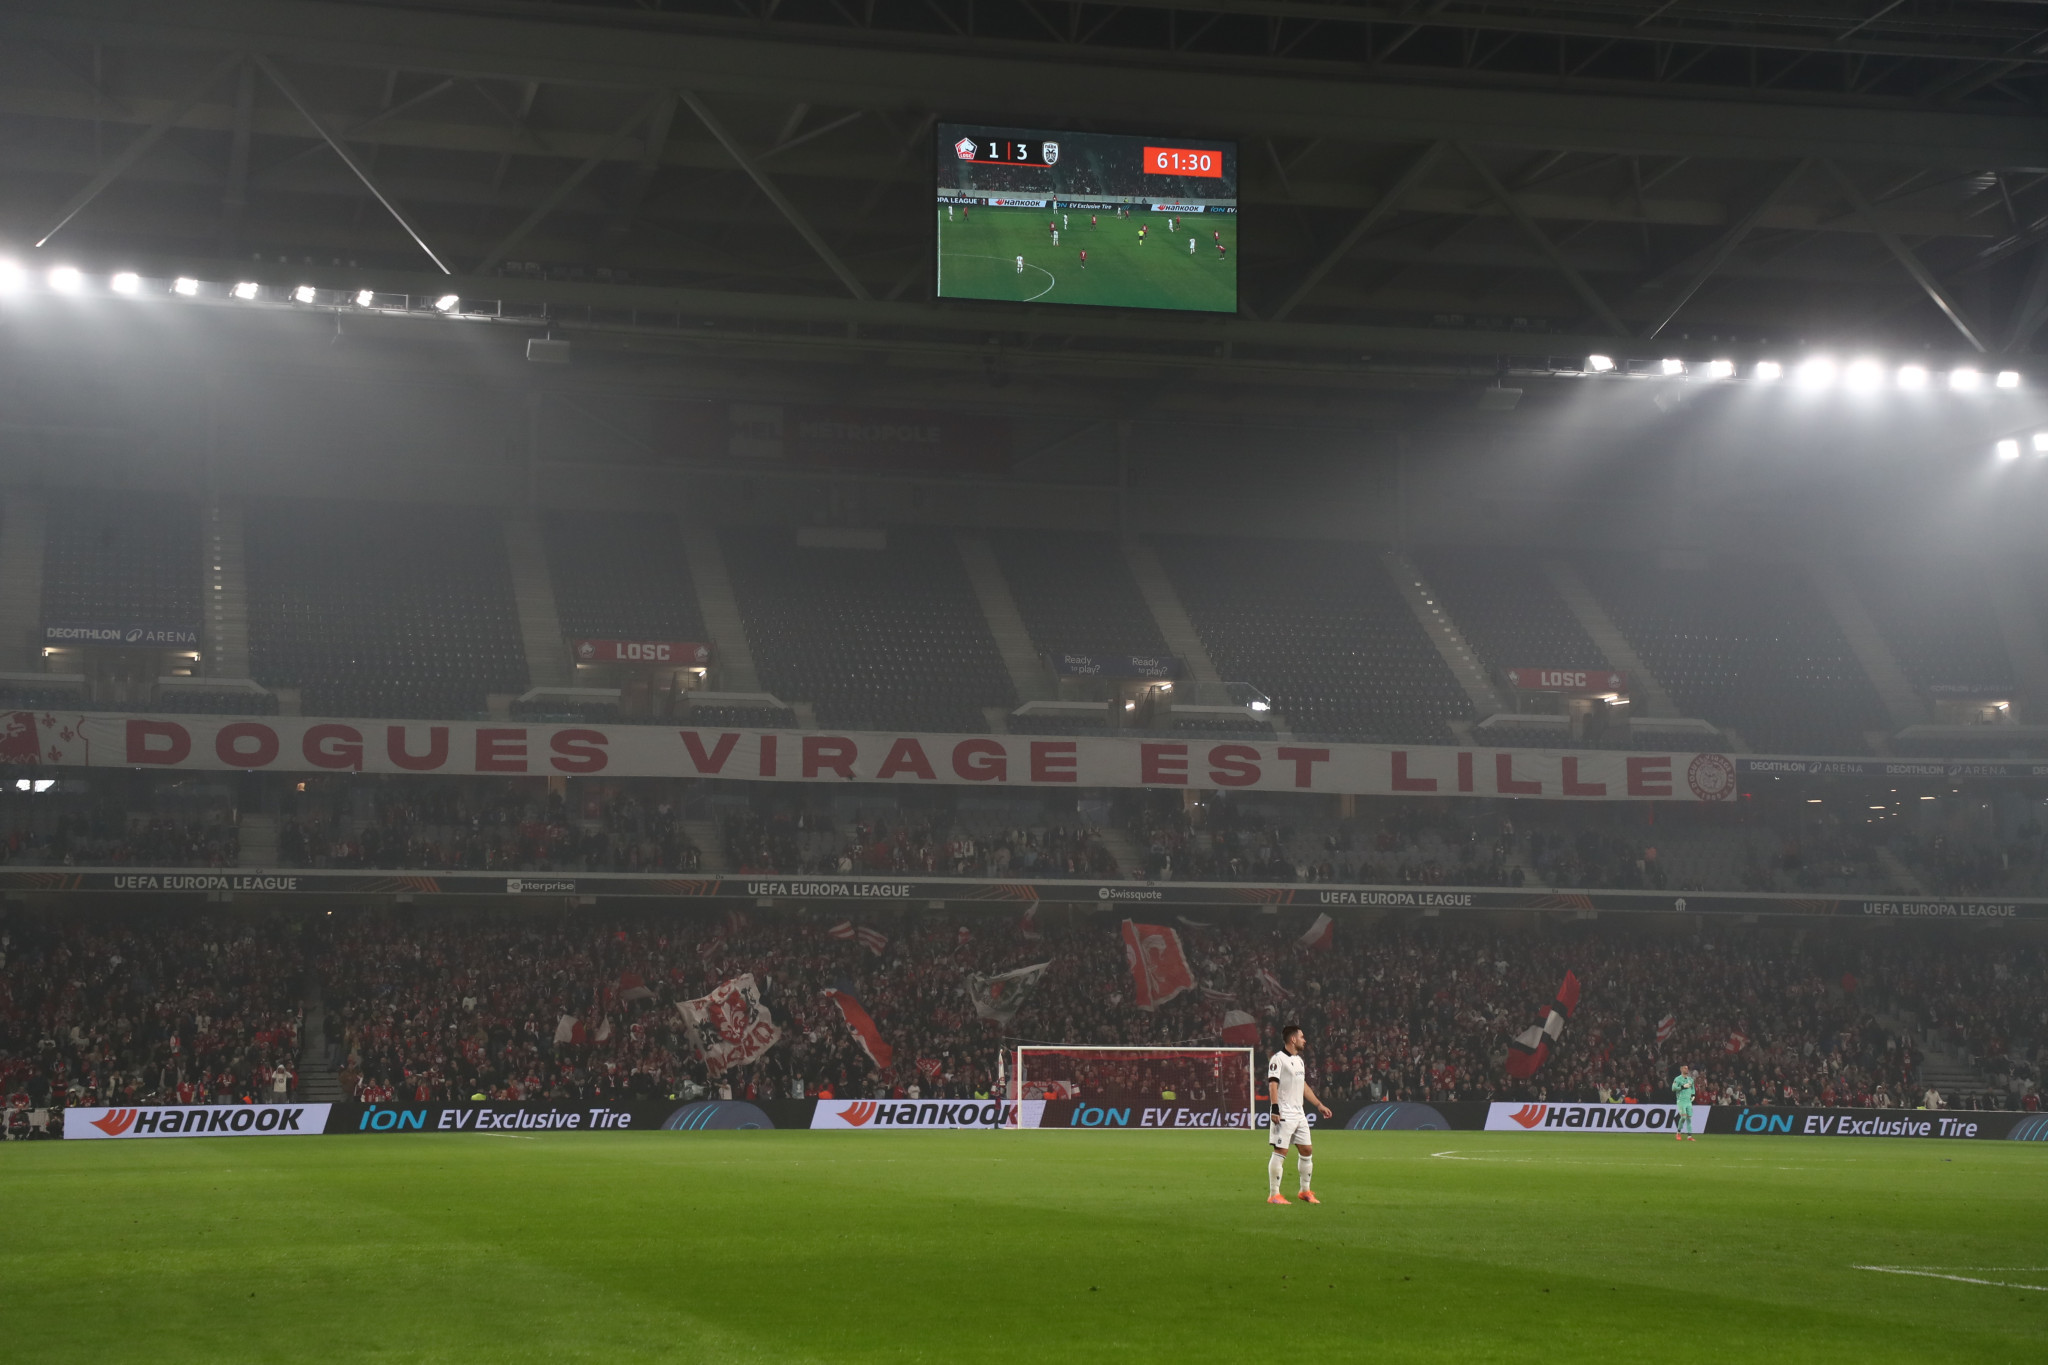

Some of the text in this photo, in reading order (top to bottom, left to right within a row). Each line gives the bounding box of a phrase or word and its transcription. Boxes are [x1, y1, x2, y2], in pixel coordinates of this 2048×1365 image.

[989, 142, 1028, 160] 1 3
[1157, 152, 1211, 171] 61:30
[47, 628, 196, 642] DECATHLON ARENA
[617, 643, 670, 660] LOSC
[1064, 655, 1092, 665] Ready
[1132, 658, 1159, 667] Ready
[1079, 665, 1100, 675] play?
[1147, 667, 1167, 676] play?
[1541, 672, 1586, 687] LOSC
[125, 719, 1673, 796] DOGUES VIRAGE EST LILLE
[1750, 761, 1864, 773] DECATHLON ARENA
[1886, 764, 2007, 775] DECATHLON ARENA
[115, 876, 297, 890] UEFA EUROPA LEAGUE
[510, 881, 574, 891] enterprise
[748, 883, 910, 897] UEFA EUROPA LEAGUE
[1110, 888, 1162, 900] Swissquote
[1320, 892, 1472, 906] UEFA EUROPA LEAGUE
[1863, 902, 2016, 917] UEFA EUROPA LEAGUE
[438, 1109, 473, 1129] EV
[475, 1108, 580, 1129] Exclusive
[588, 1108, 632, 1129] Tire
[1140, 1107, 1172, 1127] EV
[1804, 1115, 1834, 1134] EV
[1837, 1115, 1931, 1136] Exclusive
[1939, 1117, 1978, 1137] Tire
